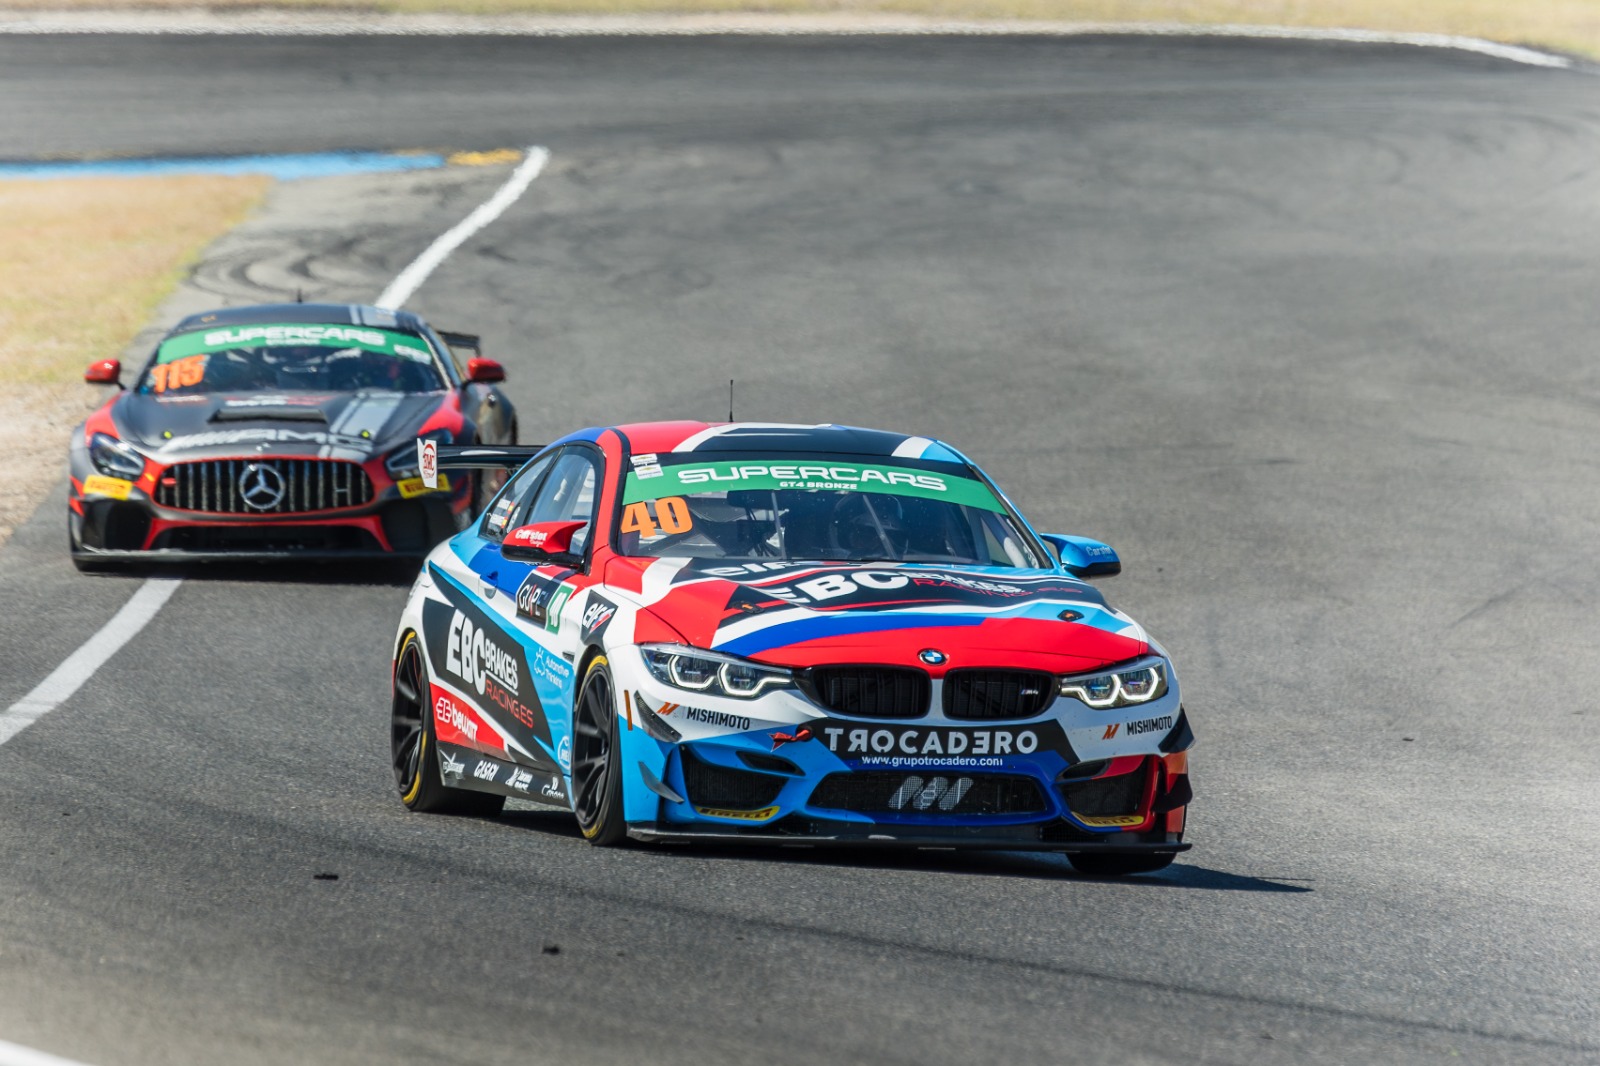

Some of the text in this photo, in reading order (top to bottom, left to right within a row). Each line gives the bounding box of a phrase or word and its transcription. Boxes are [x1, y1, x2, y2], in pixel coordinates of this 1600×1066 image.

[204, 326, 386, 346] SUPERCARS
[152, 355, 205, 392] 115
[678, 466, 947, 491] SUPERCARS
[807, 482, 857, 490] BRONZE
[621, 496, 693, 539] 40
[446, 608, 487, 695] EBC
[486, 638, 519, 690] BRAKES
[687, 706, 751, 730] MISHIMOTO
[1126, 716, 1173, 736] MISHIMOTO
[862, 755, 1003, 768] www.grupotrocadero.com
